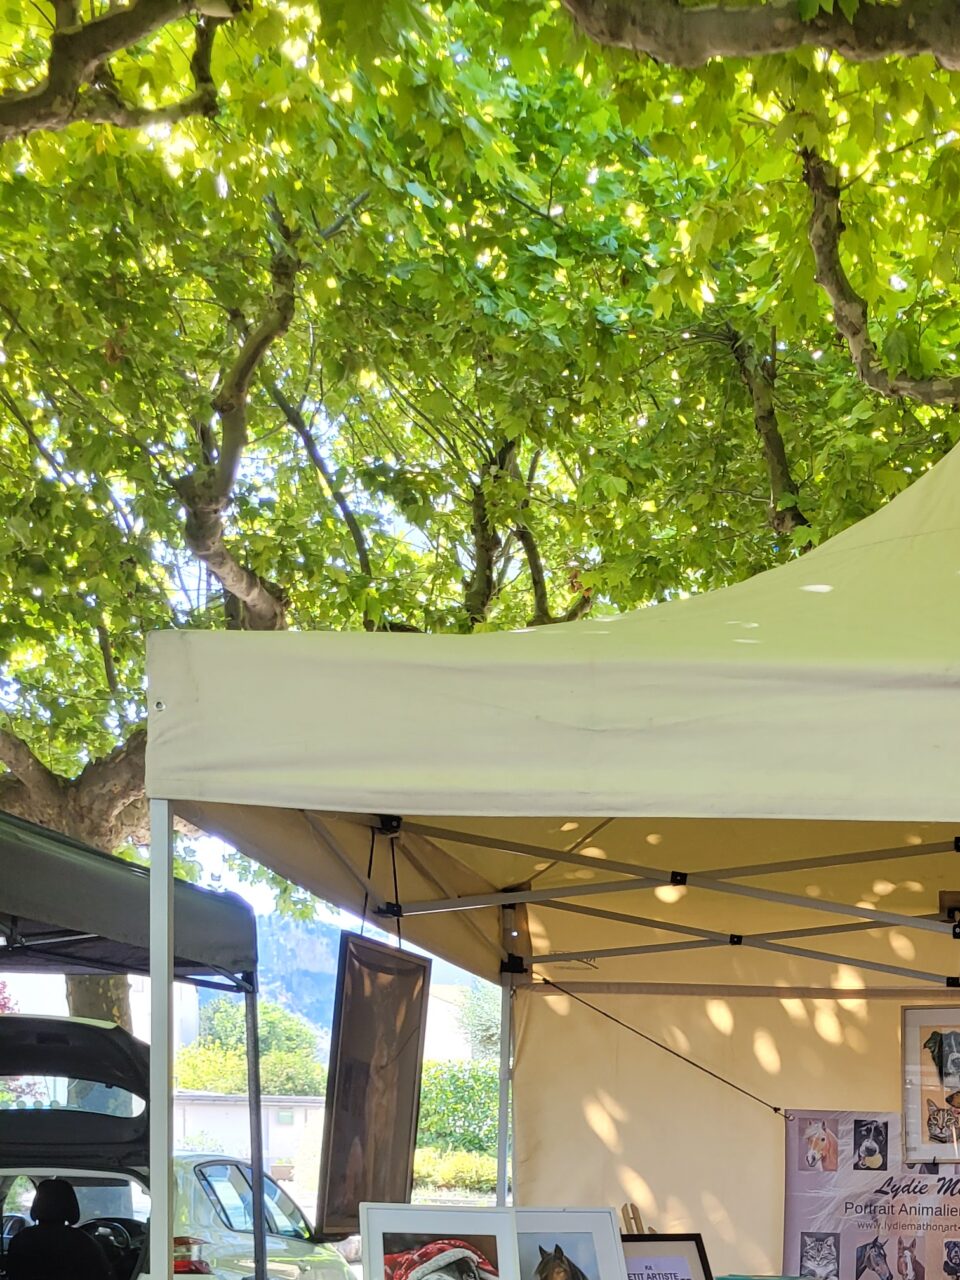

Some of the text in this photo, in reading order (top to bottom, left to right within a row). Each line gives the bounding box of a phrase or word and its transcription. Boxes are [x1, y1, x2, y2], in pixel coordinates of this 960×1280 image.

[873, 1176, 929, 1200] Lydie
[844, 1201, 895, 1215] Portrait
[646, 1273, 679, 1280] ARTISTE
